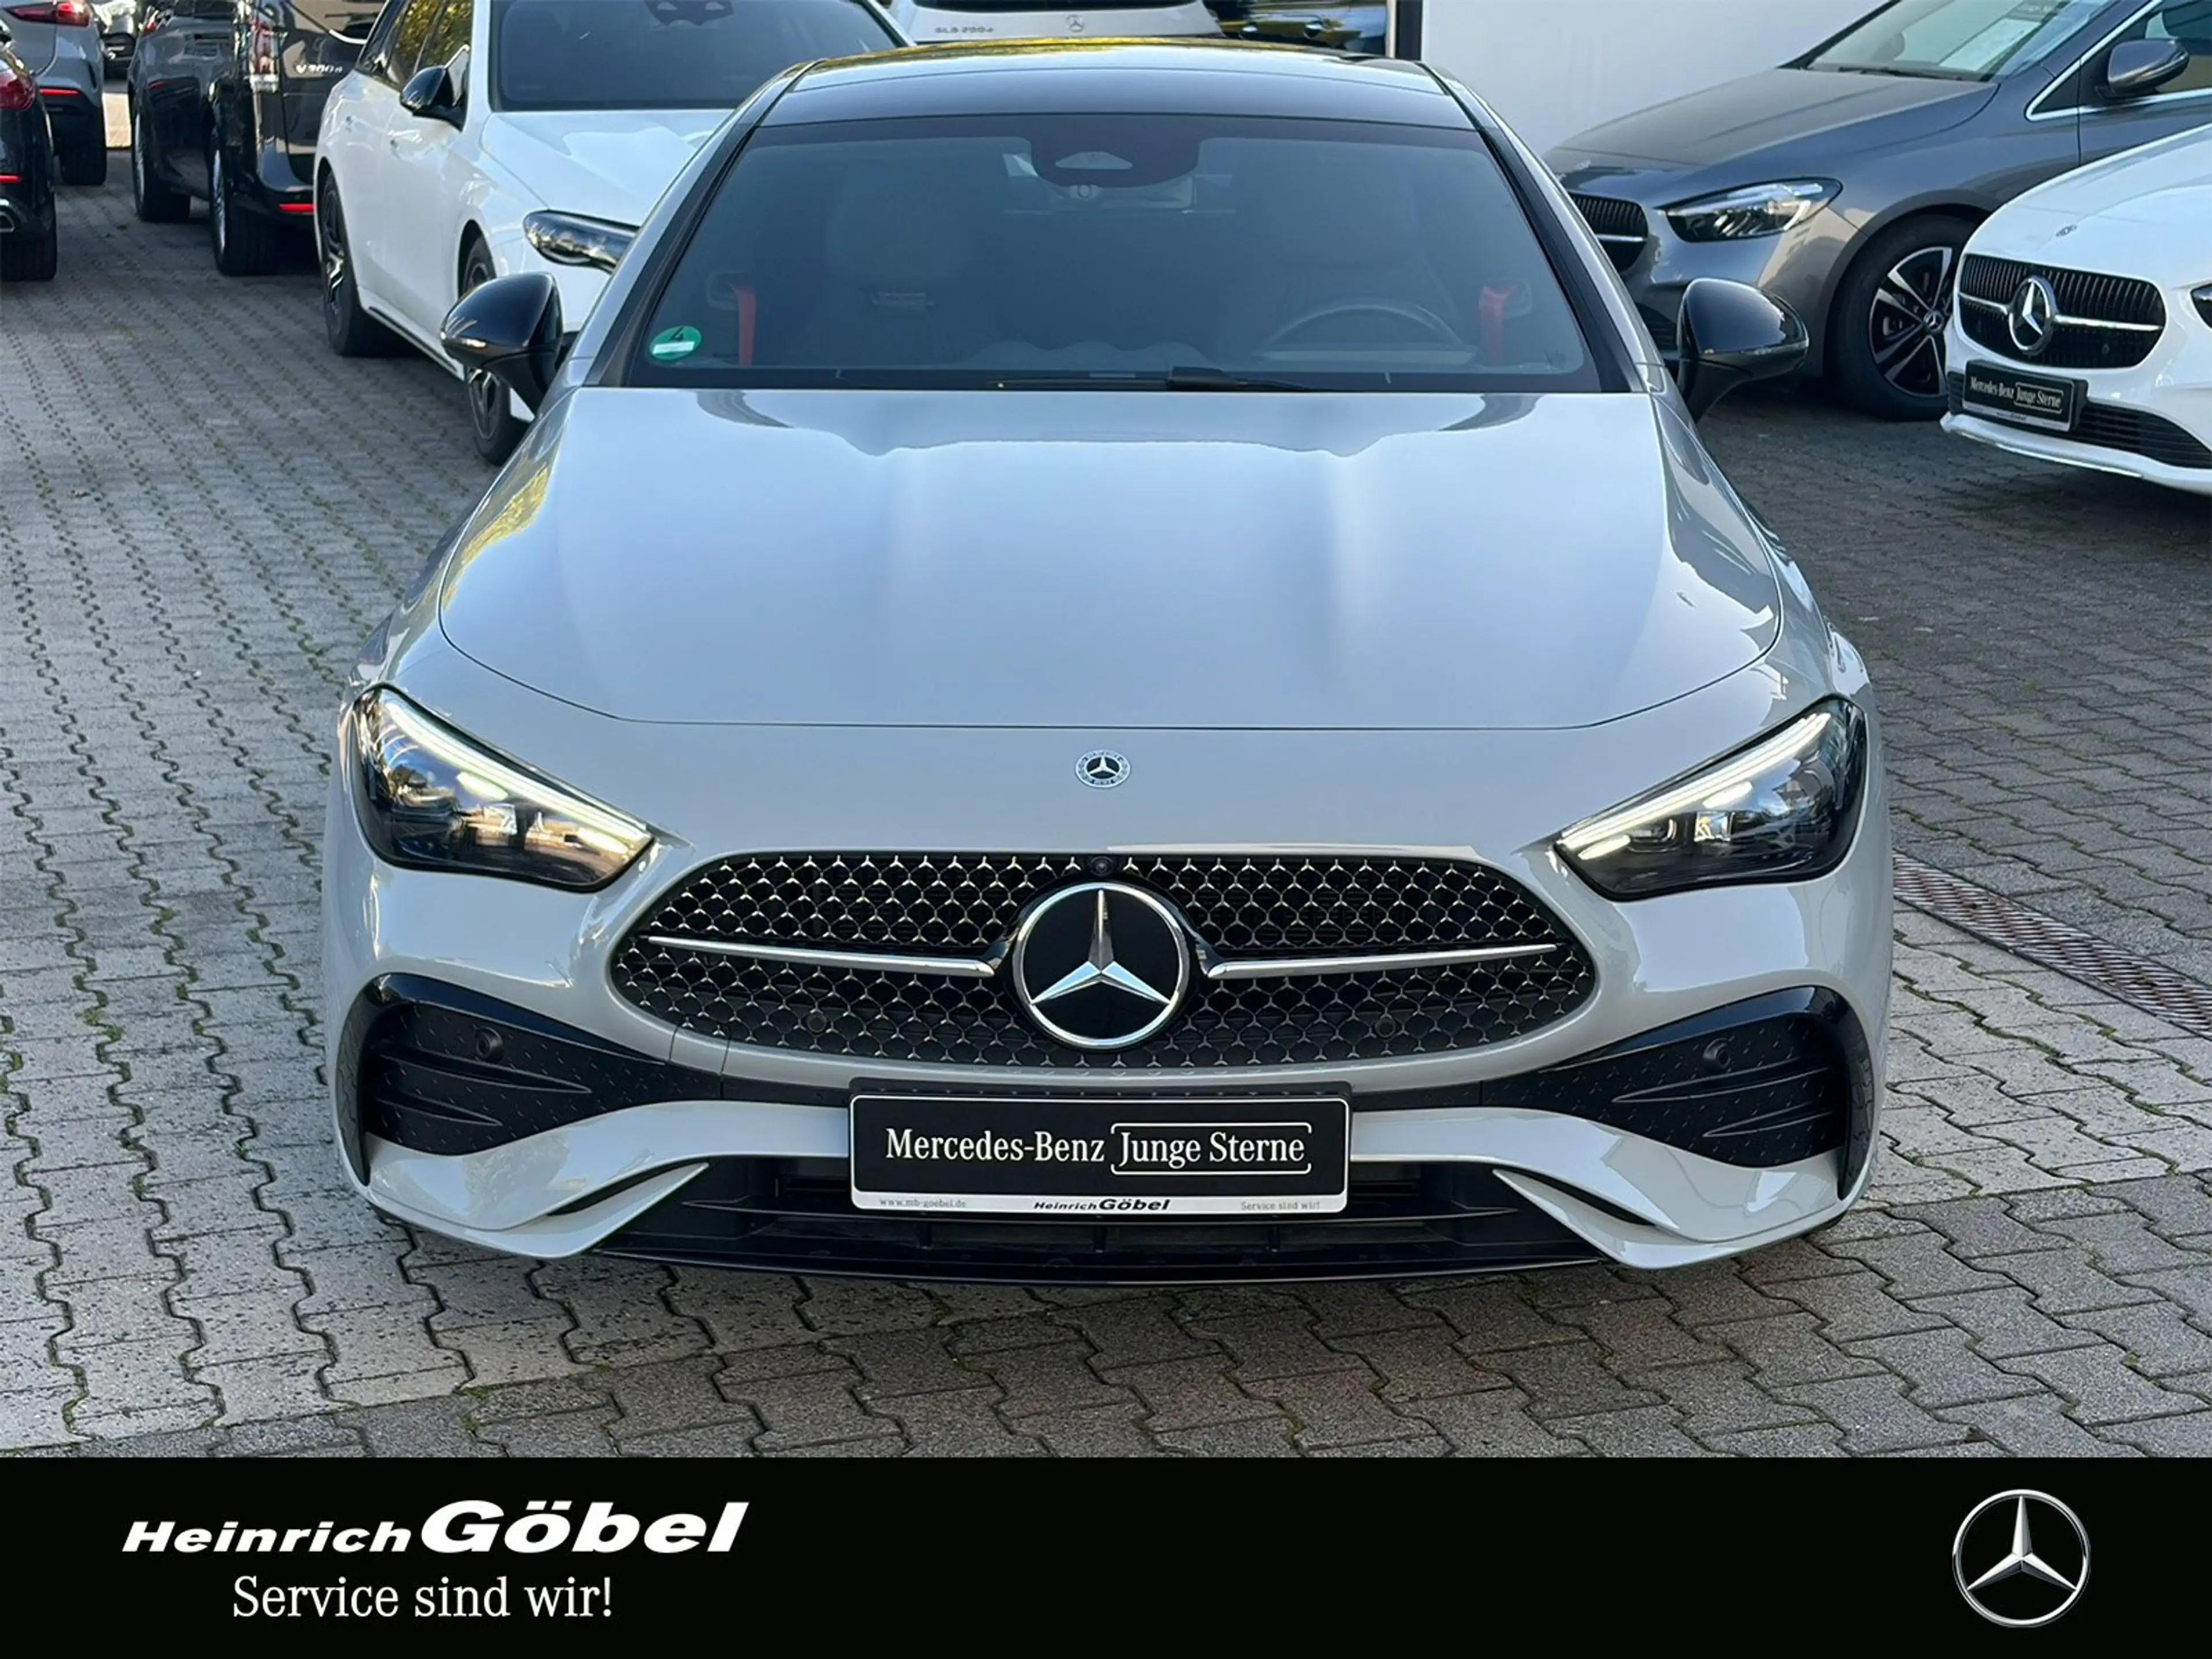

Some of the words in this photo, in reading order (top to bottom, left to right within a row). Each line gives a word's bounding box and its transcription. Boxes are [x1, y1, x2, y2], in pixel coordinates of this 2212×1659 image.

[670, 327, 684, 342] 4
[885, 1128, 1105, 1162] Mercedes-Benz
[1118, 1131, 1202, 1169] Junge
[1209, 1131, 1305, 1162] Sterne
[880, 1198, 967, 1209] www.mb-goebel.de
[1241, 1200, 1276, 1211] Service
[1278, 1201, 1298, 1210] sind
